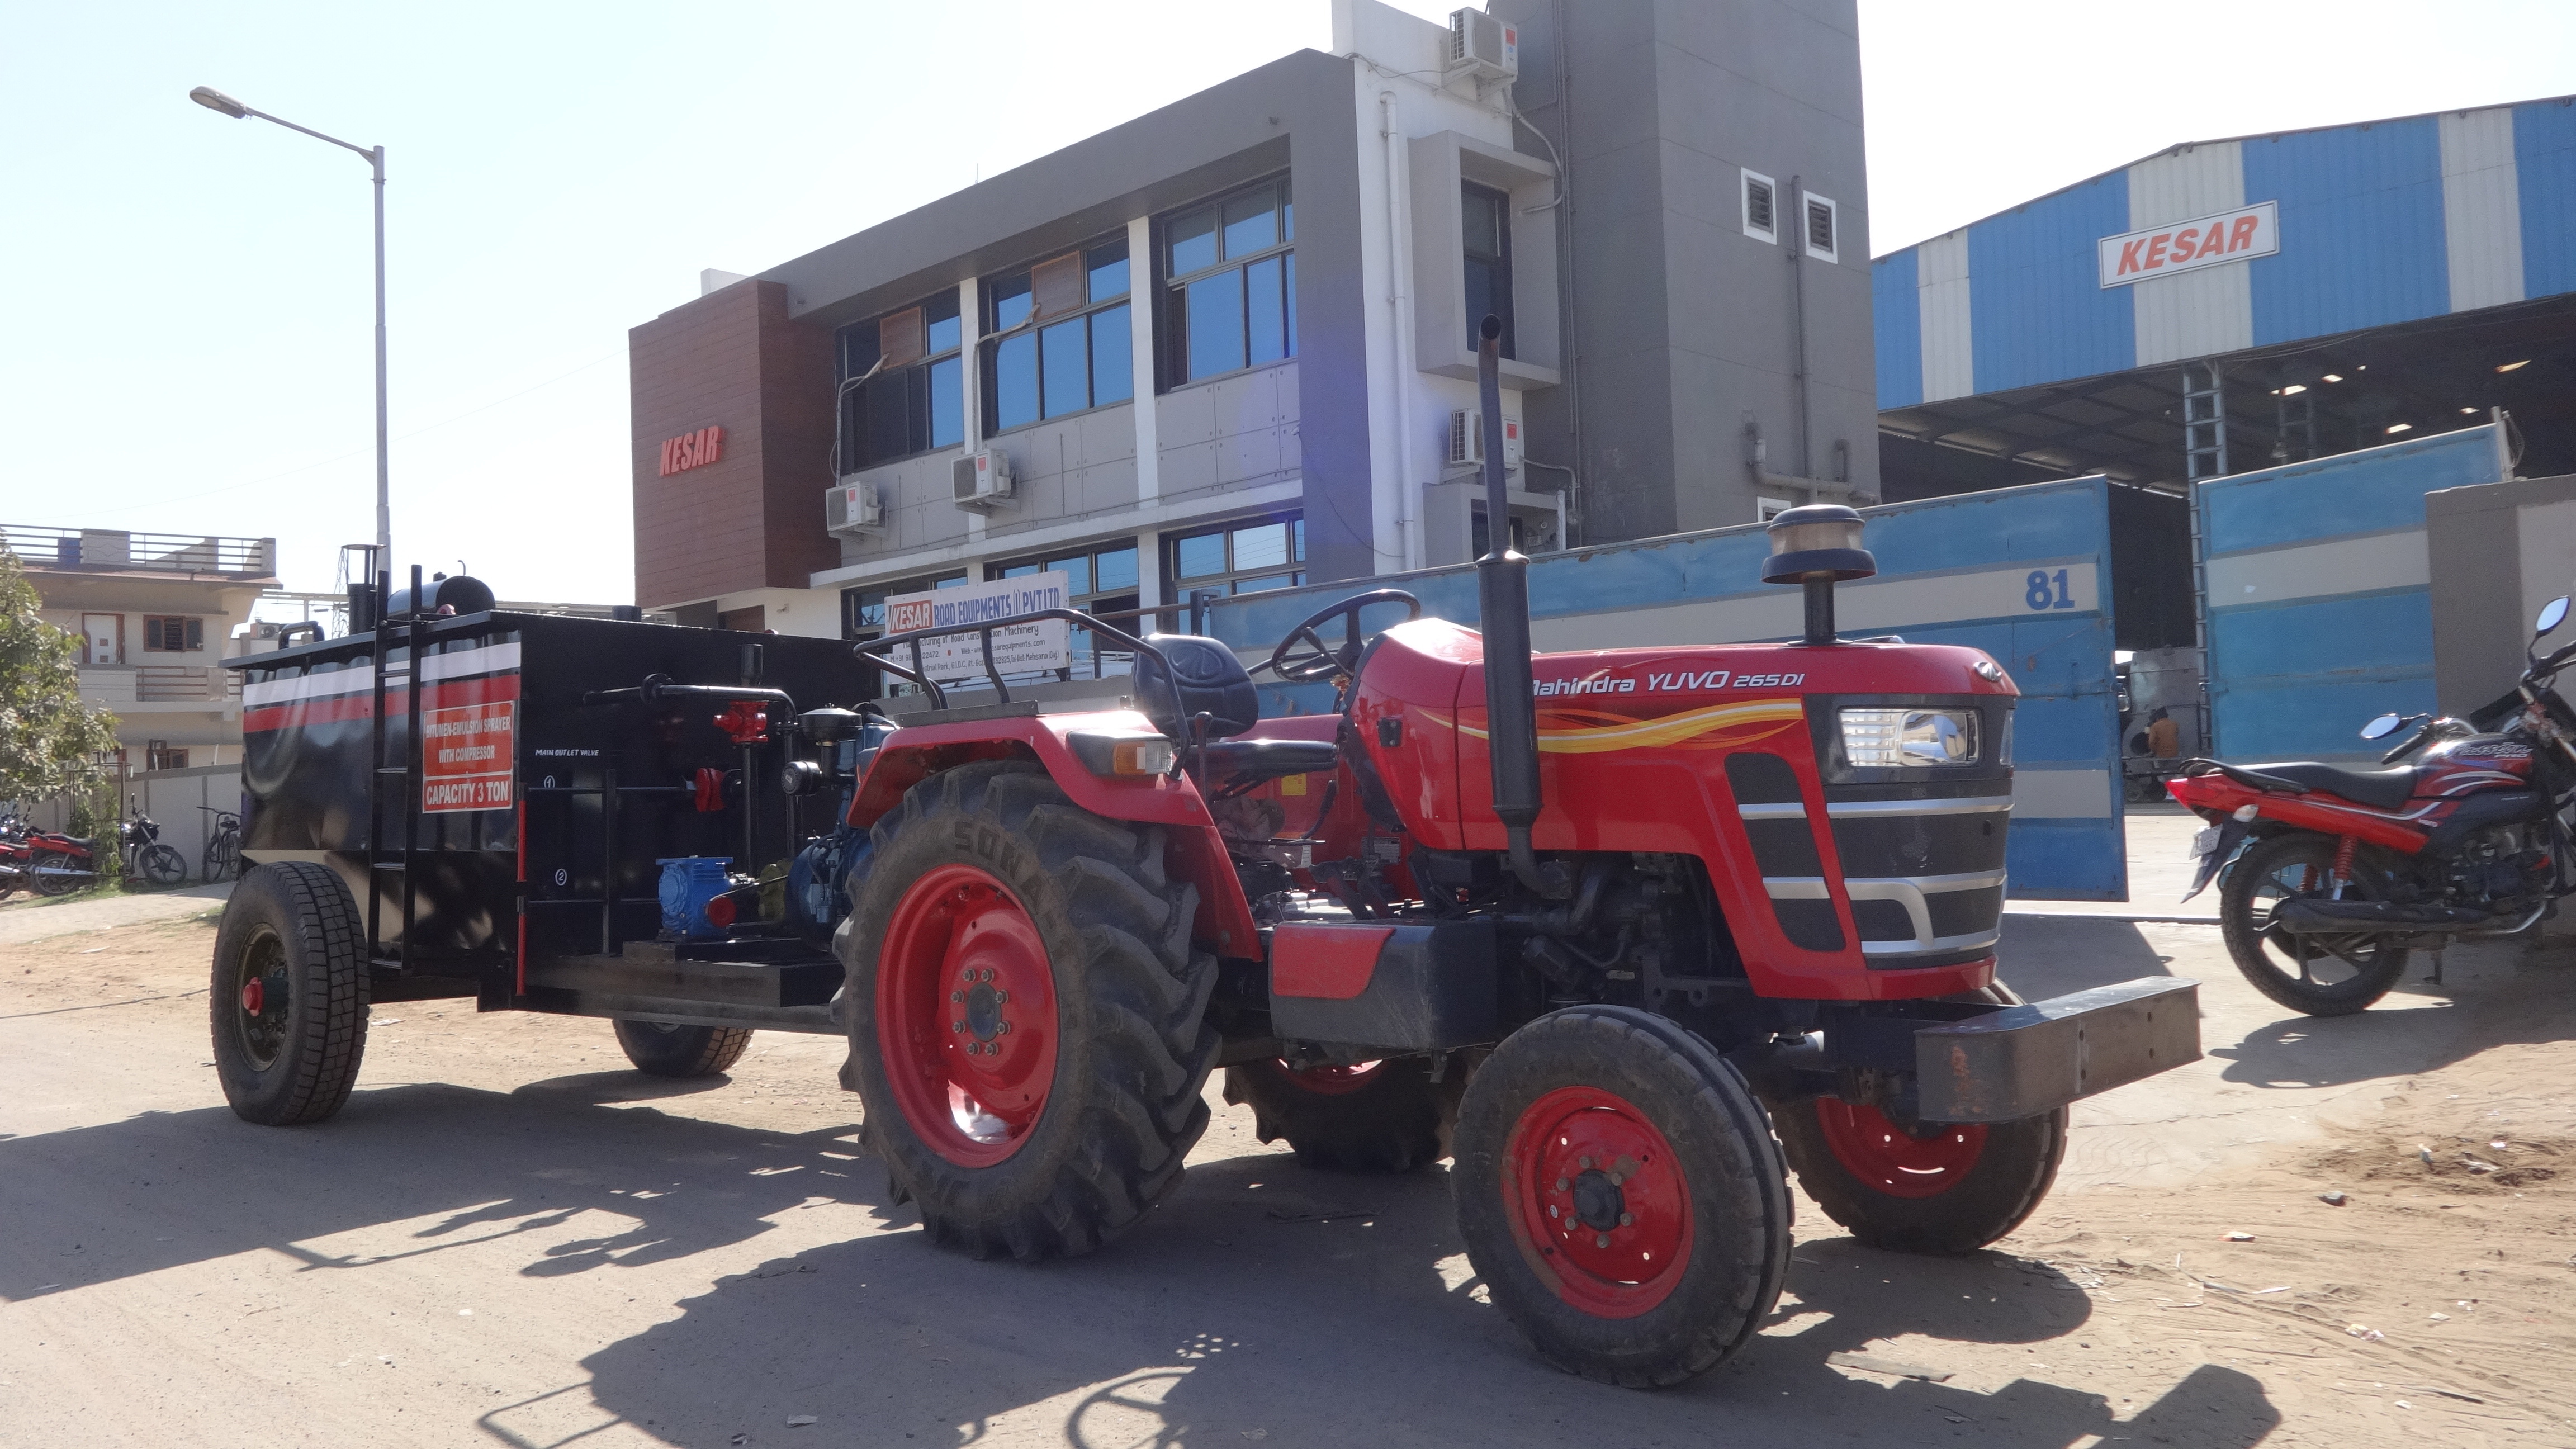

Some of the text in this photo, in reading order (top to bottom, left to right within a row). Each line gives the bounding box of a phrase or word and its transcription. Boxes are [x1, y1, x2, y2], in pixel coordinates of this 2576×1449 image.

[2116, 215, 2259, 276] KESAR
[659, 425, 723, 477] KESAR
[2025, 569, 2075, 610] 81
[891, 602, 931, 631] KESAR
[934, 602, 956, 627] ROAD
[958, 594, 1011, 624] EQUIPMENTS
[951, 633, 964, 643] Road
[1005, 624, 1039, 636] Machinery
[1647, 671, 1731, 691] YUVO
[484, 716, 511, 733] SPRAYER
[439, 745, 495, 763] WITH COMPRESSOR
[427, 780, 509, 805] CAPACITY 3 TON
